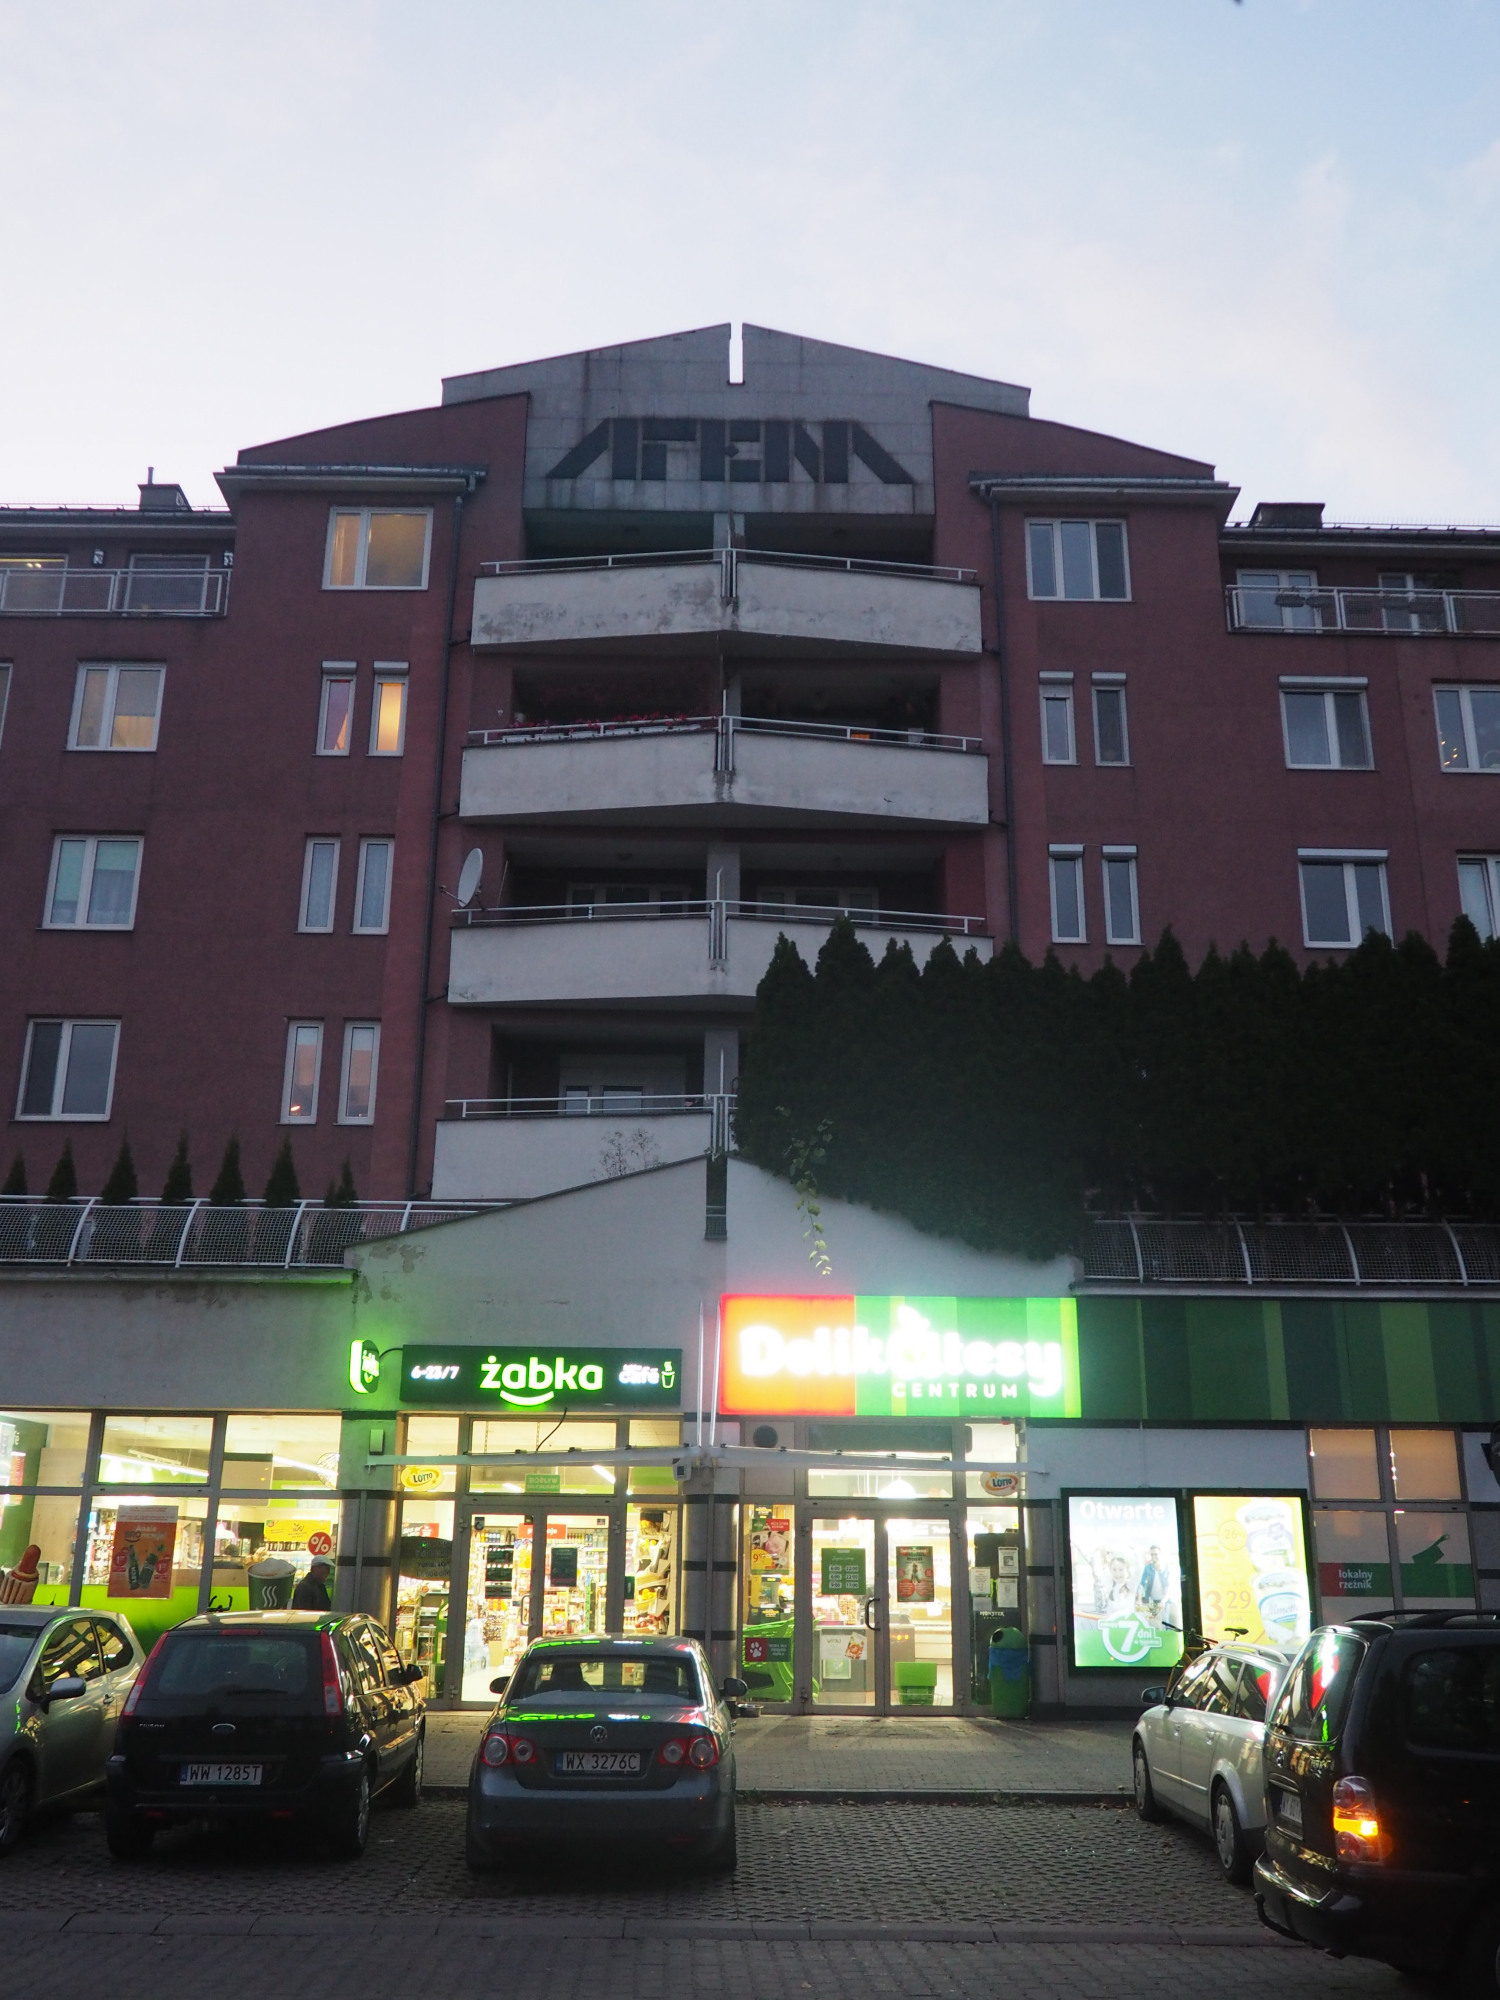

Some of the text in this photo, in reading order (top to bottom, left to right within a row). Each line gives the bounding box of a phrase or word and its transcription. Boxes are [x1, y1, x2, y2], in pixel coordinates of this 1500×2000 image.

[480, 1355, 603, 1390] żabka
[892, 1382, 1018, 1398] CENTRUM
[413, 1472, 433, 1483] LOTTO
[992, 1478, 1012, 1487] LOTTO
[1080, 1500, 1165, 1520] Otwarte
[1338, 1569, 1373, 1580] lokalny
[1204, 1590, 1252, 1623] 3 29
[1118, 1620, 1152, 1652] 7 dni
[566, 1754, 637, 1769] WX 3276C
[190, 1766, 260, 1780] WW 1285T
